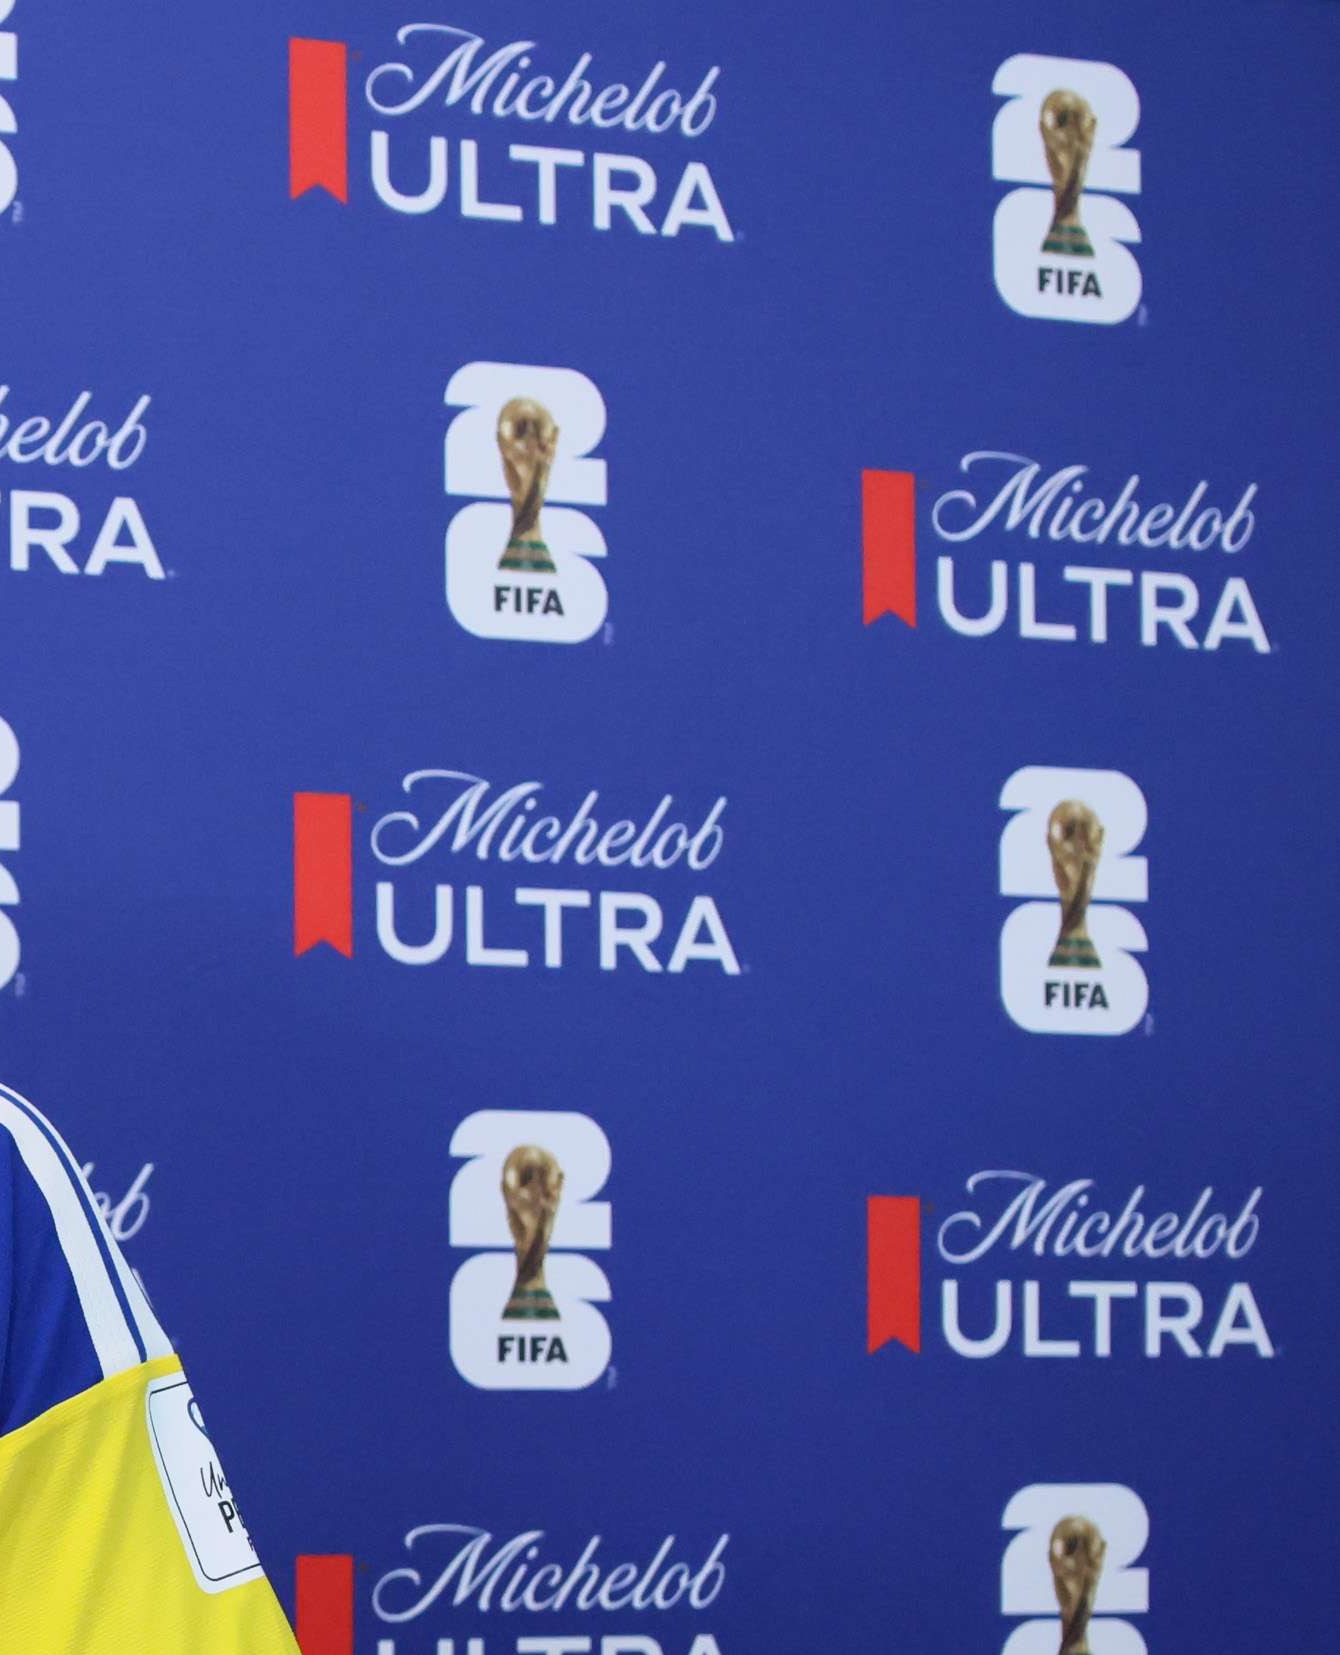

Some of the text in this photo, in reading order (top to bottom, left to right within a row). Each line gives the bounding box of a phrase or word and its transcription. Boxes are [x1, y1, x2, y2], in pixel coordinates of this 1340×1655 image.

[366, 23, 719, 137] Michelob
[371, 131, 734, 242] ULTRA
[1038, 268, 1101, 297] FIFA
[932, 451, 1257, 553] Michelob
[495, 586, 564, 615] FIFA
[937, 556, 1270, 653] ULTRA
[371, 769, 726, 870] Michelob
[376, 882, 740, 975] ULTRA
[1045, 982, 1108, 1008] FIFA
[938, 1171, 1261, 1264] Michelob
[498, 1336, 567, 1362] FIFA
[942, 1279, 1274, 1358] ULTRA
[373, 1524, 729, 1622] Michelob
